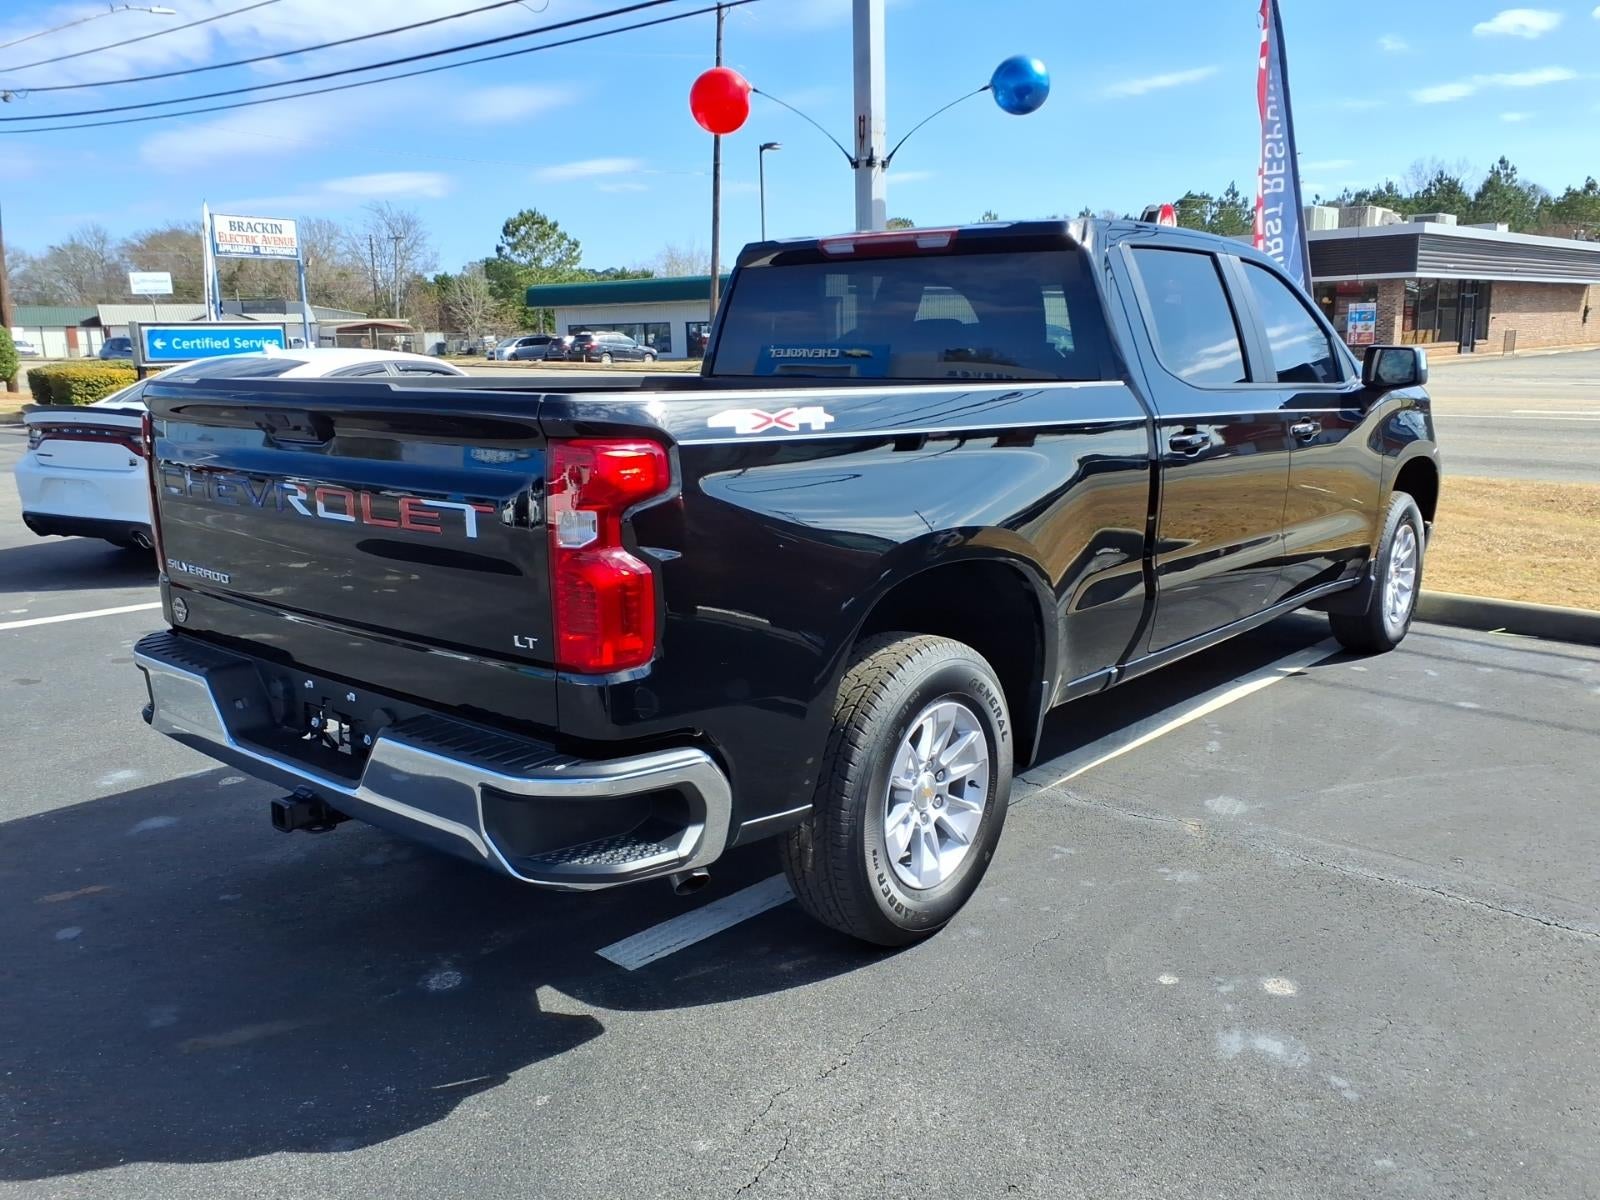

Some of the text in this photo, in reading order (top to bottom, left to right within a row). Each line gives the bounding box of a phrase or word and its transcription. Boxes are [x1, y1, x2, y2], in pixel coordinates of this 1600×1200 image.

[228, 220, 283, 235] BRACKIN
[218, 231, 296, 247] ELECTRIC AVENUE
[172, 337, 280, 350] Certified Service
[163, 466, 496, 538] CHEVROLET
[167, 558, 230, 584] SILVERADO
[513, 635, 539, 650] LT
[968, 678, 1009, 743] GENERAL
